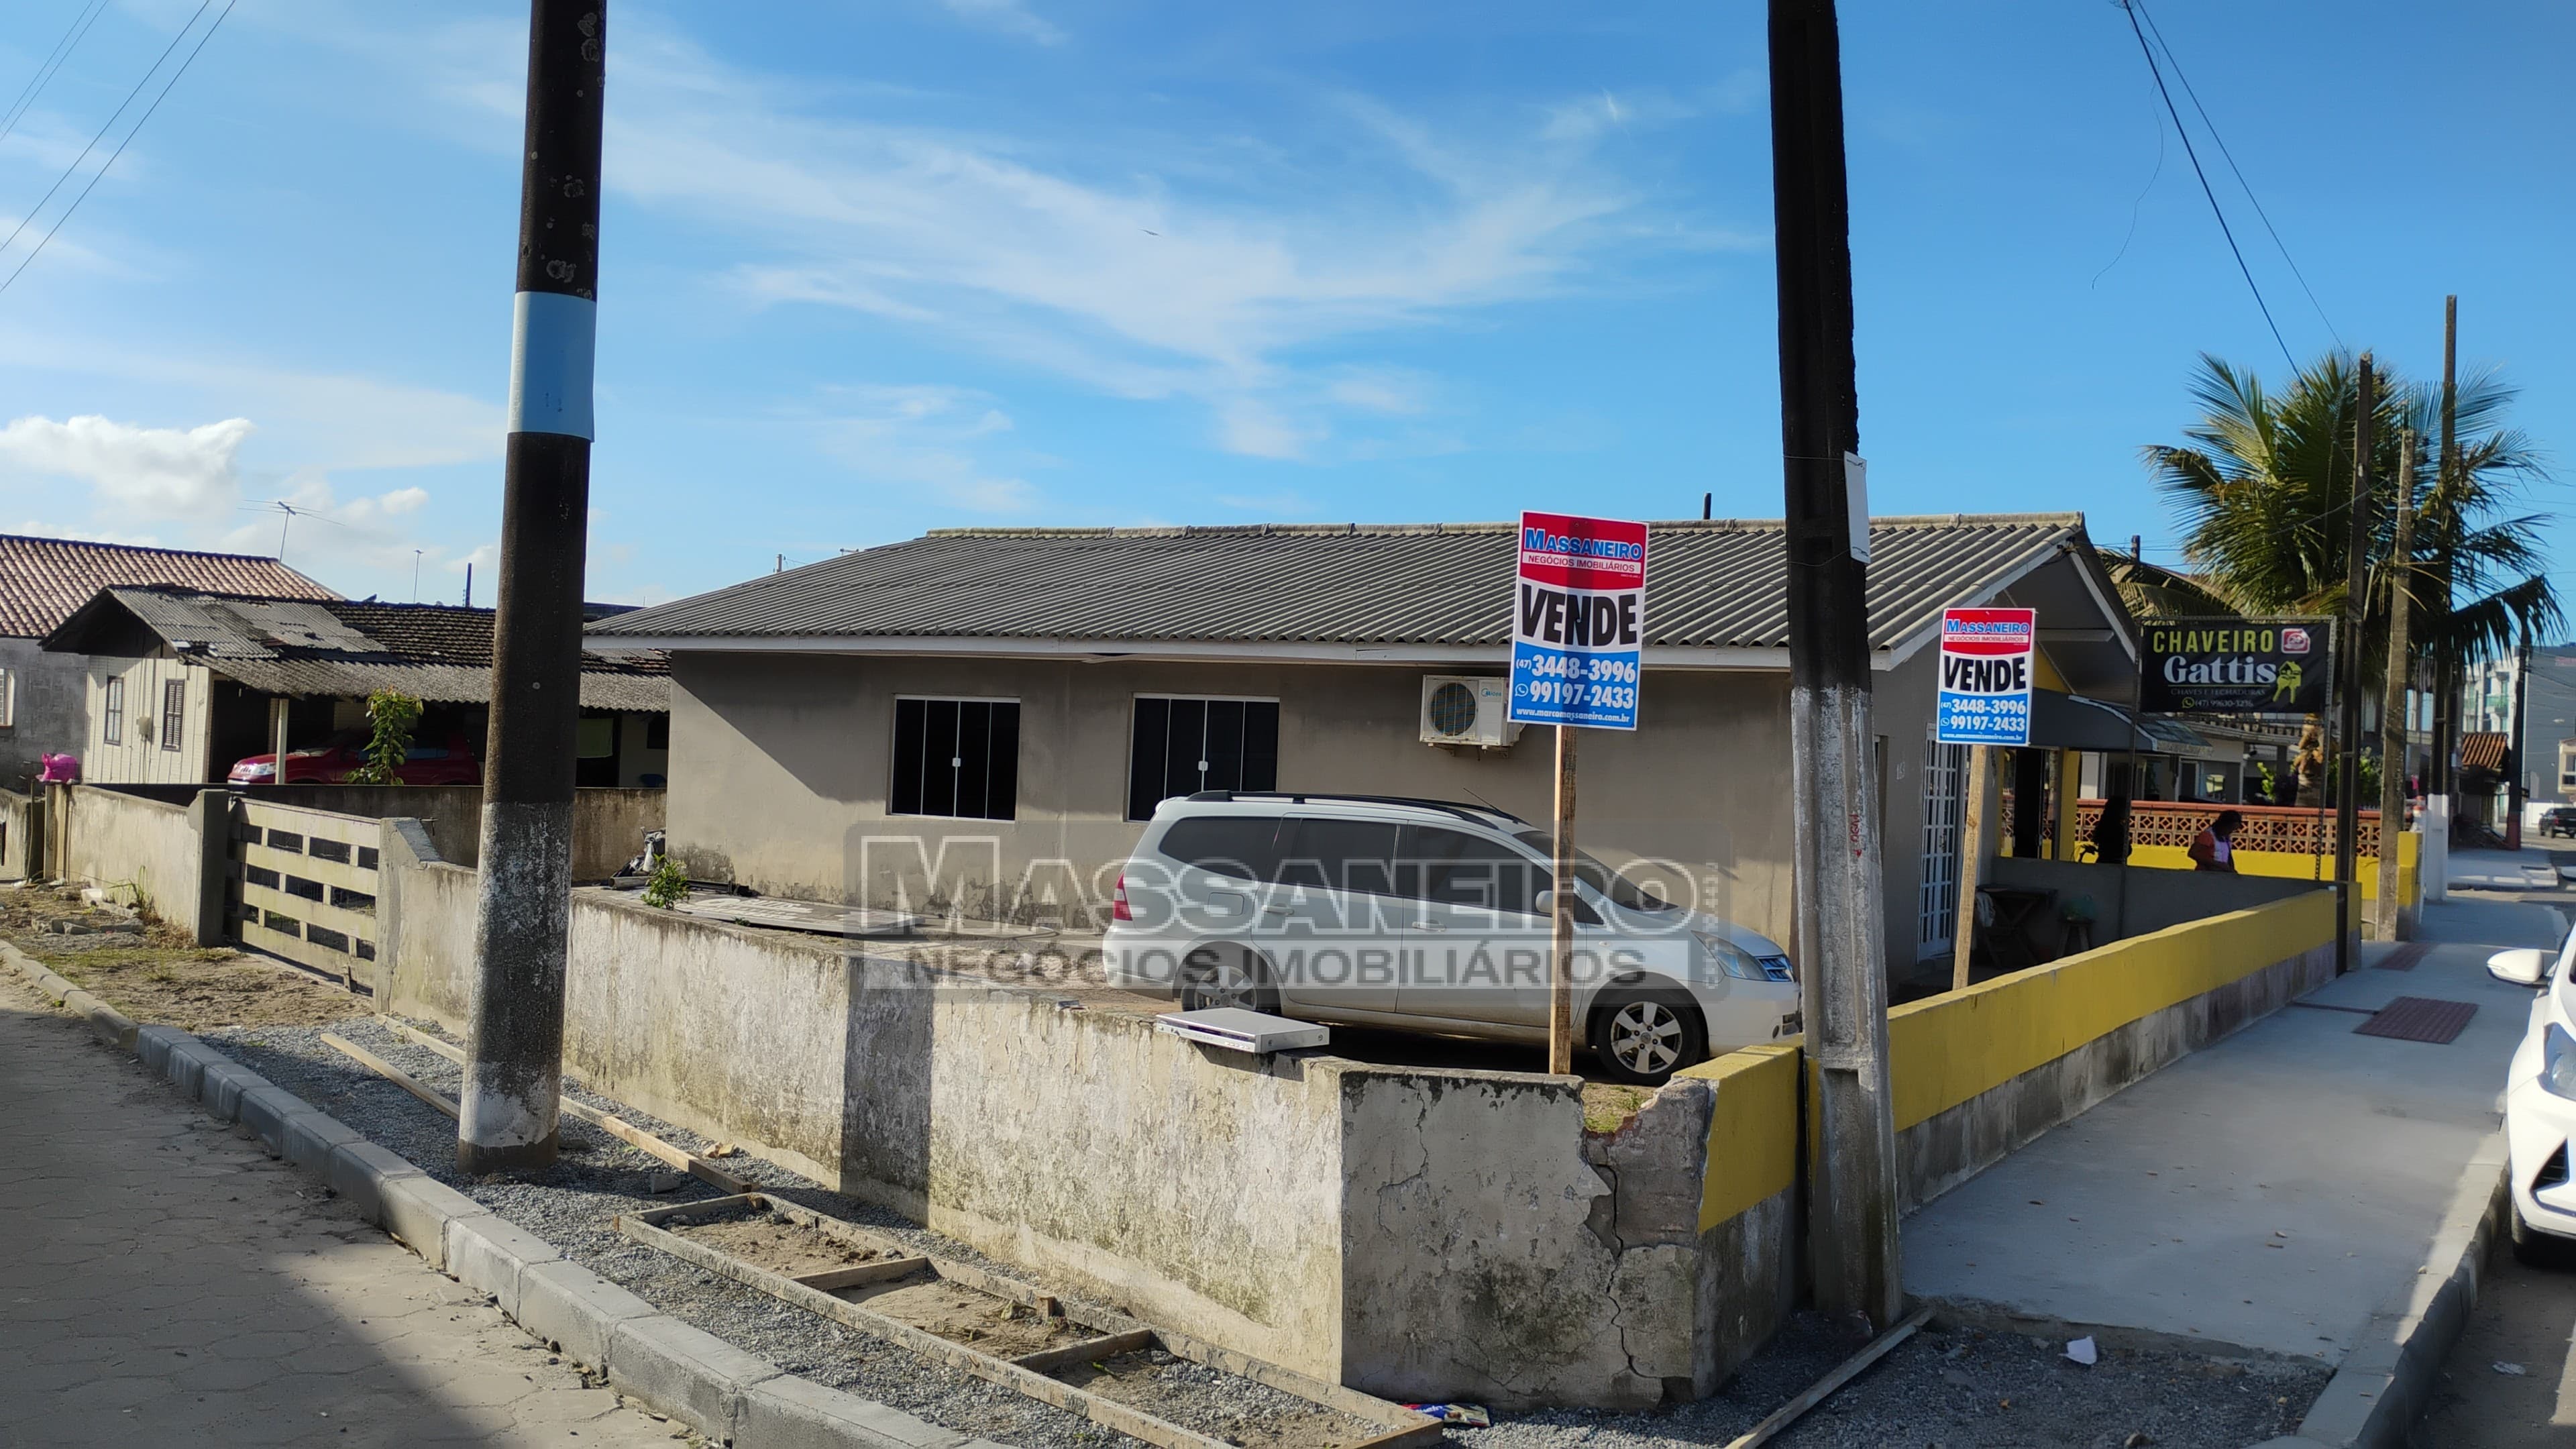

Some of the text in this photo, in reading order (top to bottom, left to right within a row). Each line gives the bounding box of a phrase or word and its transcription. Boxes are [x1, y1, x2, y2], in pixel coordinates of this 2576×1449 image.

[1524, 527, 1643, 560] MASSANEIRO
[1528, 555, 1635, 572] NEGÓCIOS IMOBILIÁRIOS
[1521, 583, 1638, 647] VENDE
[1946, 619, 2029, 634] MASSANEIRO
[2153, 629, 2274, 653] CHAVEIRO
[1515, 654, 1636, 683] (47) 3448-3996
[1943, 655, 2027, 692] VENDE
[2163, 655, 2277, 684] Gattis
[1530, 680, 1634, 709] 99197-2433
[1951, 698, 2026, 715] 3448-3996
[1516, 708, 1630, 722] www.marcomassaneiro.com.br
[1950, 715, 2025, 732] 99197-2433
